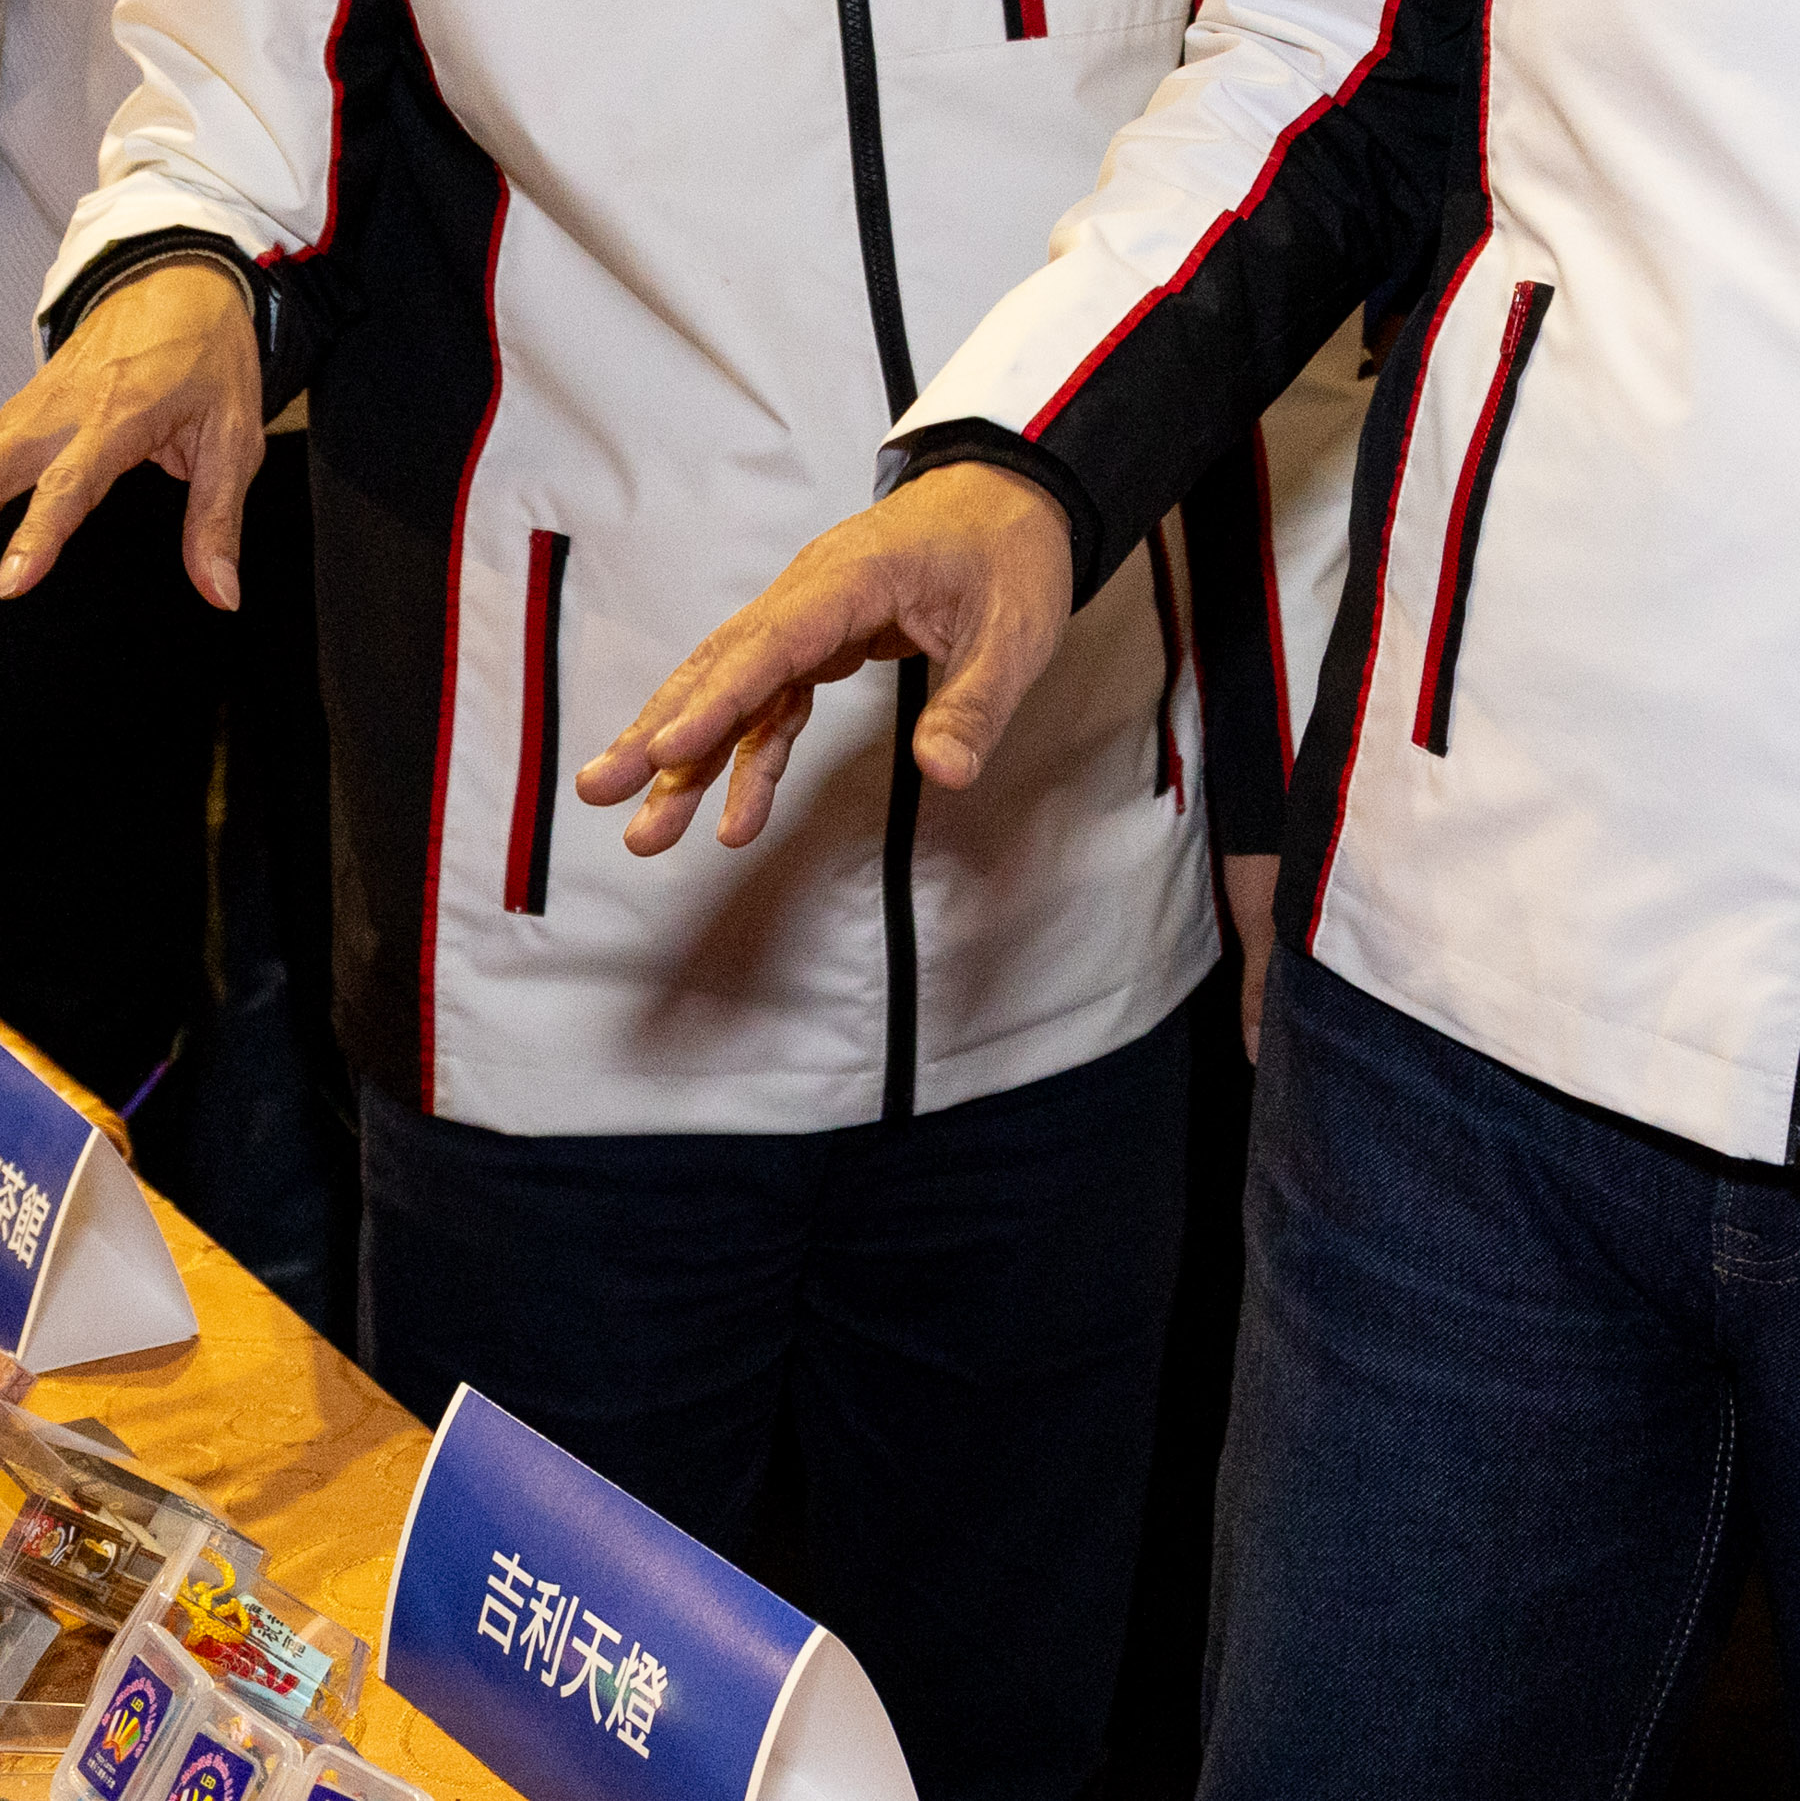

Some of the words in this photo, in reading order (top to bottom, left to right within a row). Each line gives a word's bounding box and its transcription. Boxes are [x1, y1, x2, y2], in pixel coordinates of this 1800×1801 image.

[476, 1550, 669, 1760] 吉利天燈
[200, 1772, 217, 1790] LED
